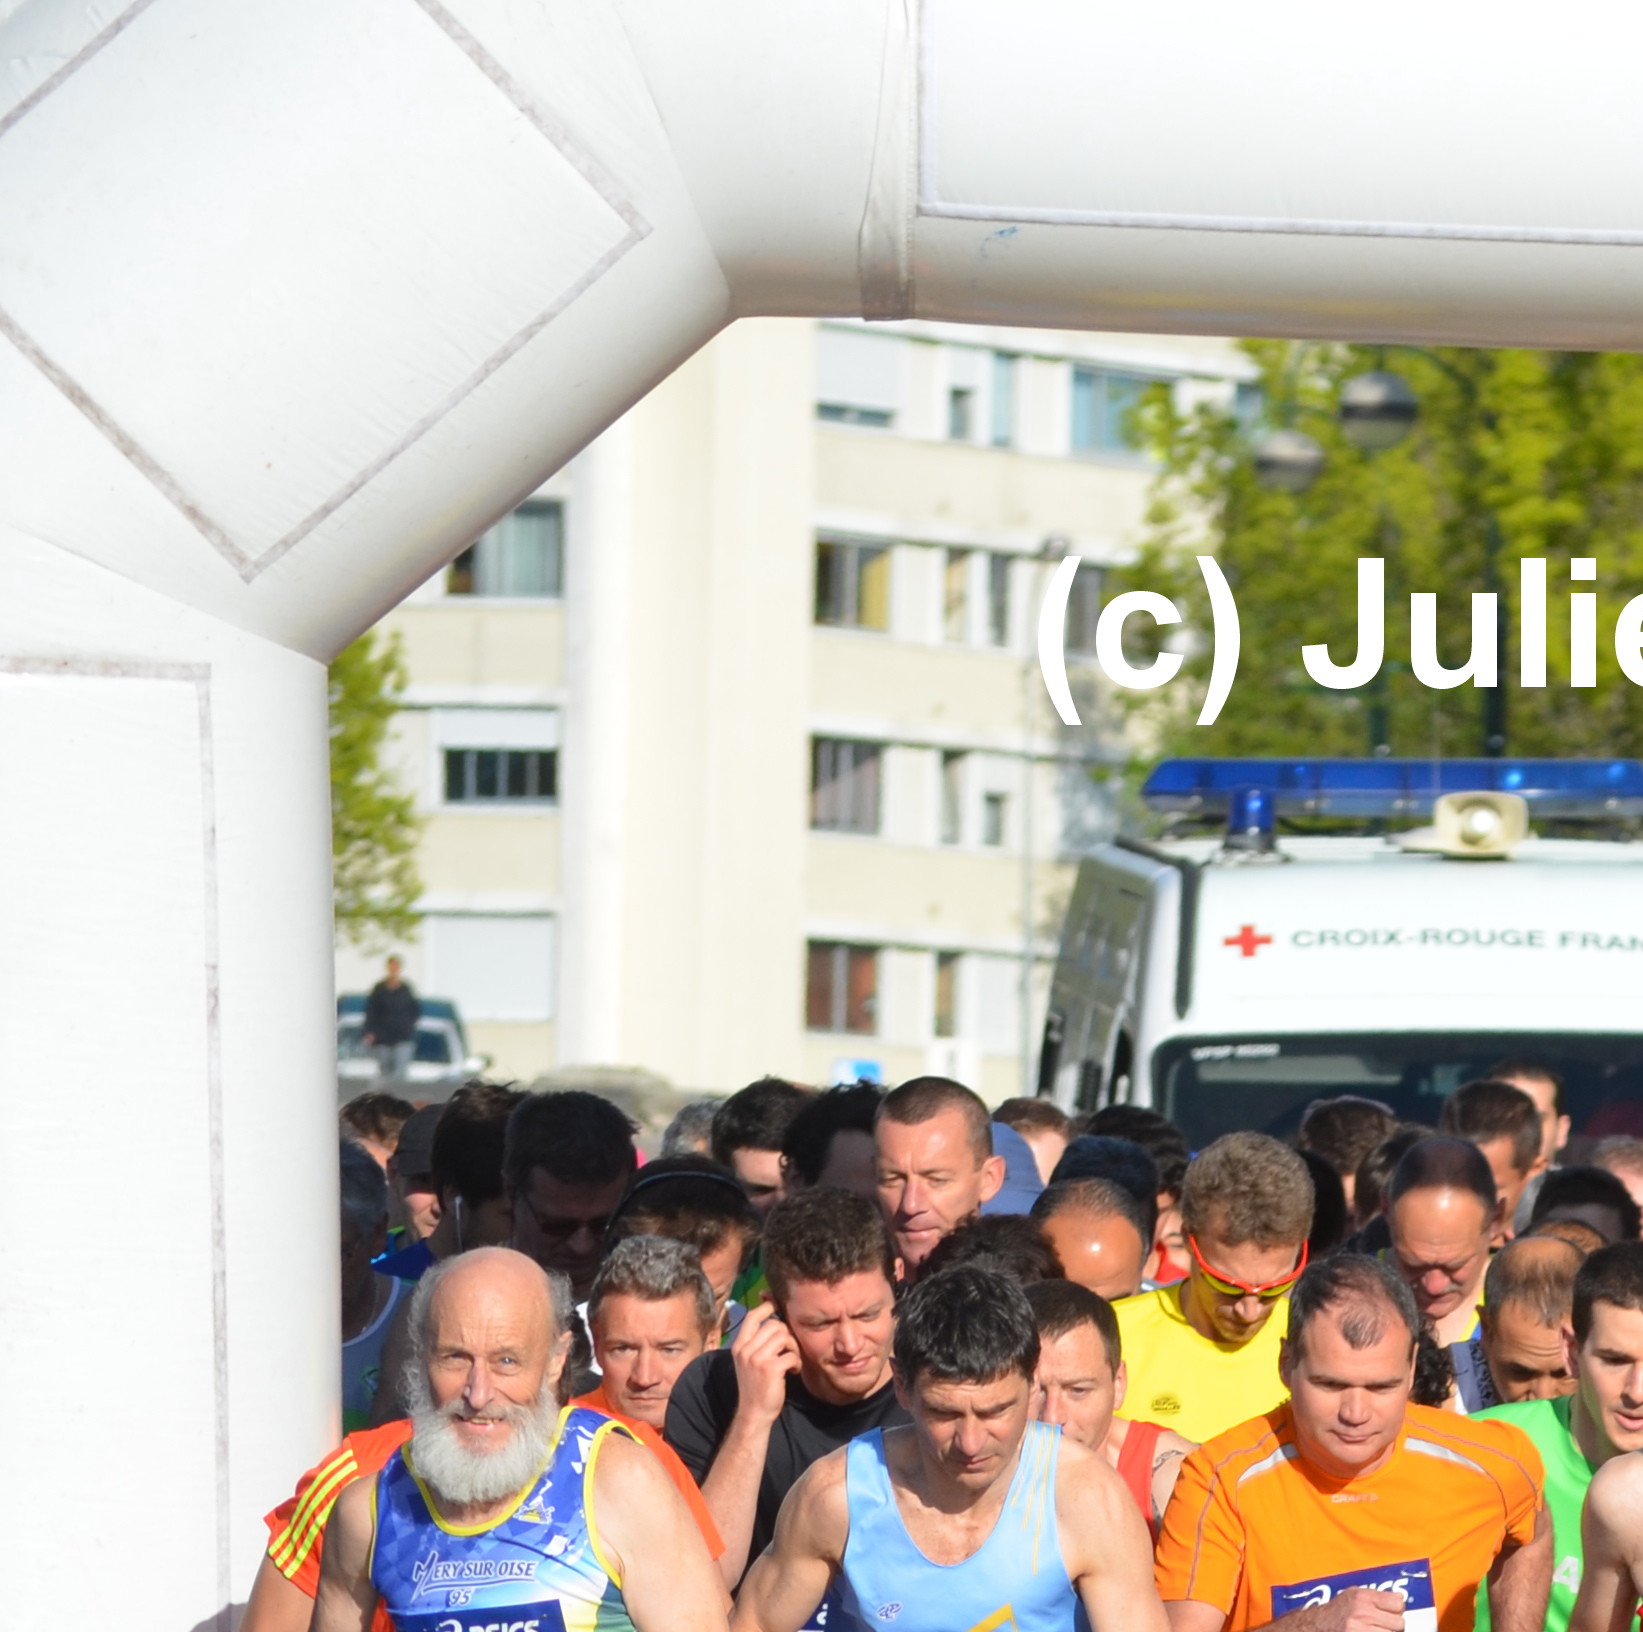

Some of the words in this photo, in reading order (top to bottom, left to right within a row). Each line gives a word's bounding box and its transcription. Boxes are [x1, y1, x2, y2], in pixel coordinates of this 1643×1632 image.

[1291, 927, 1546, 948] CROIX-ROUGE
[463, 1560, 494, 1578] SUR
[498, 1560, 537, 1577] OISE
[449, 1588, 473, 1607] 95
